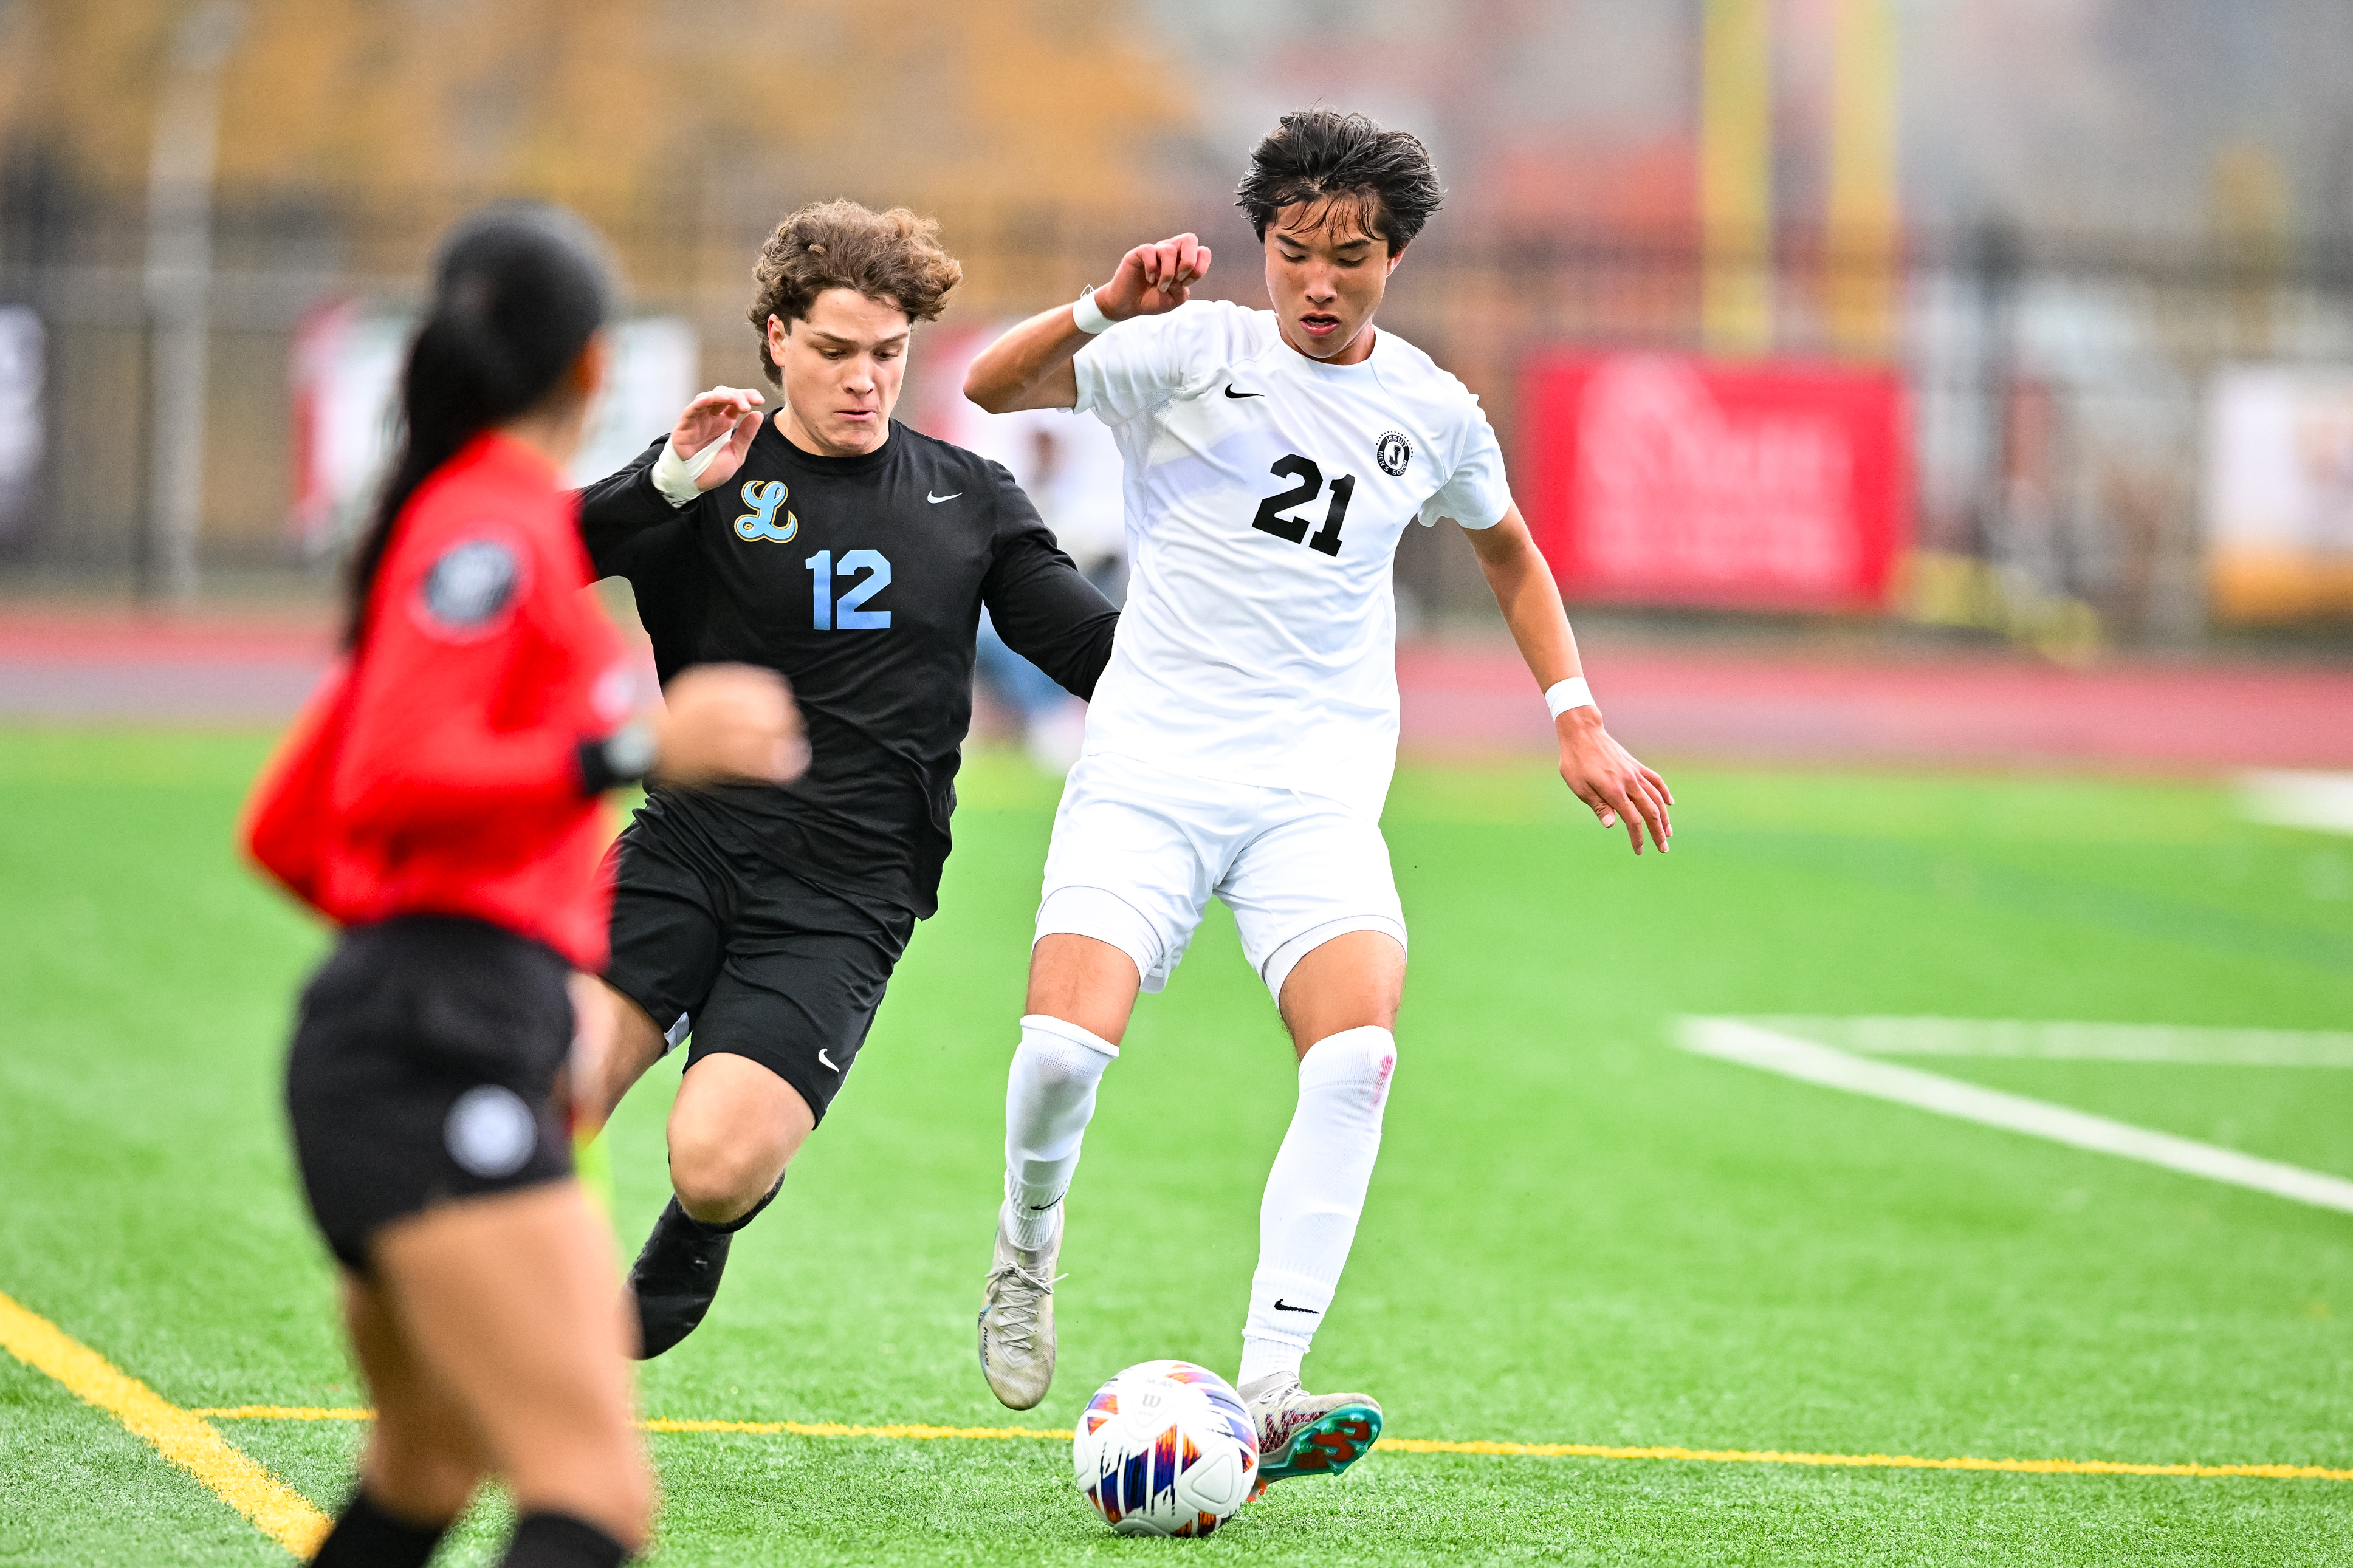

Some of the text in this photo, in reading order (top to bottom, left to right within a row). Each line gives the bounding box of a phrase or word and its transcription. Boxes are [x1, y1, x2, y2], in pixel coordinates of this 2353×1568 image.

[1378, 451, 1408, 475] MEN'S SOCCER
[1386, 436, 1408, 448] JESUIT
[1389, 445, 1402, 467] J
[733, 480, 799, 544] L
[1252, 453, 1356, 557] 21
[805, 550, 891, 631] 12
